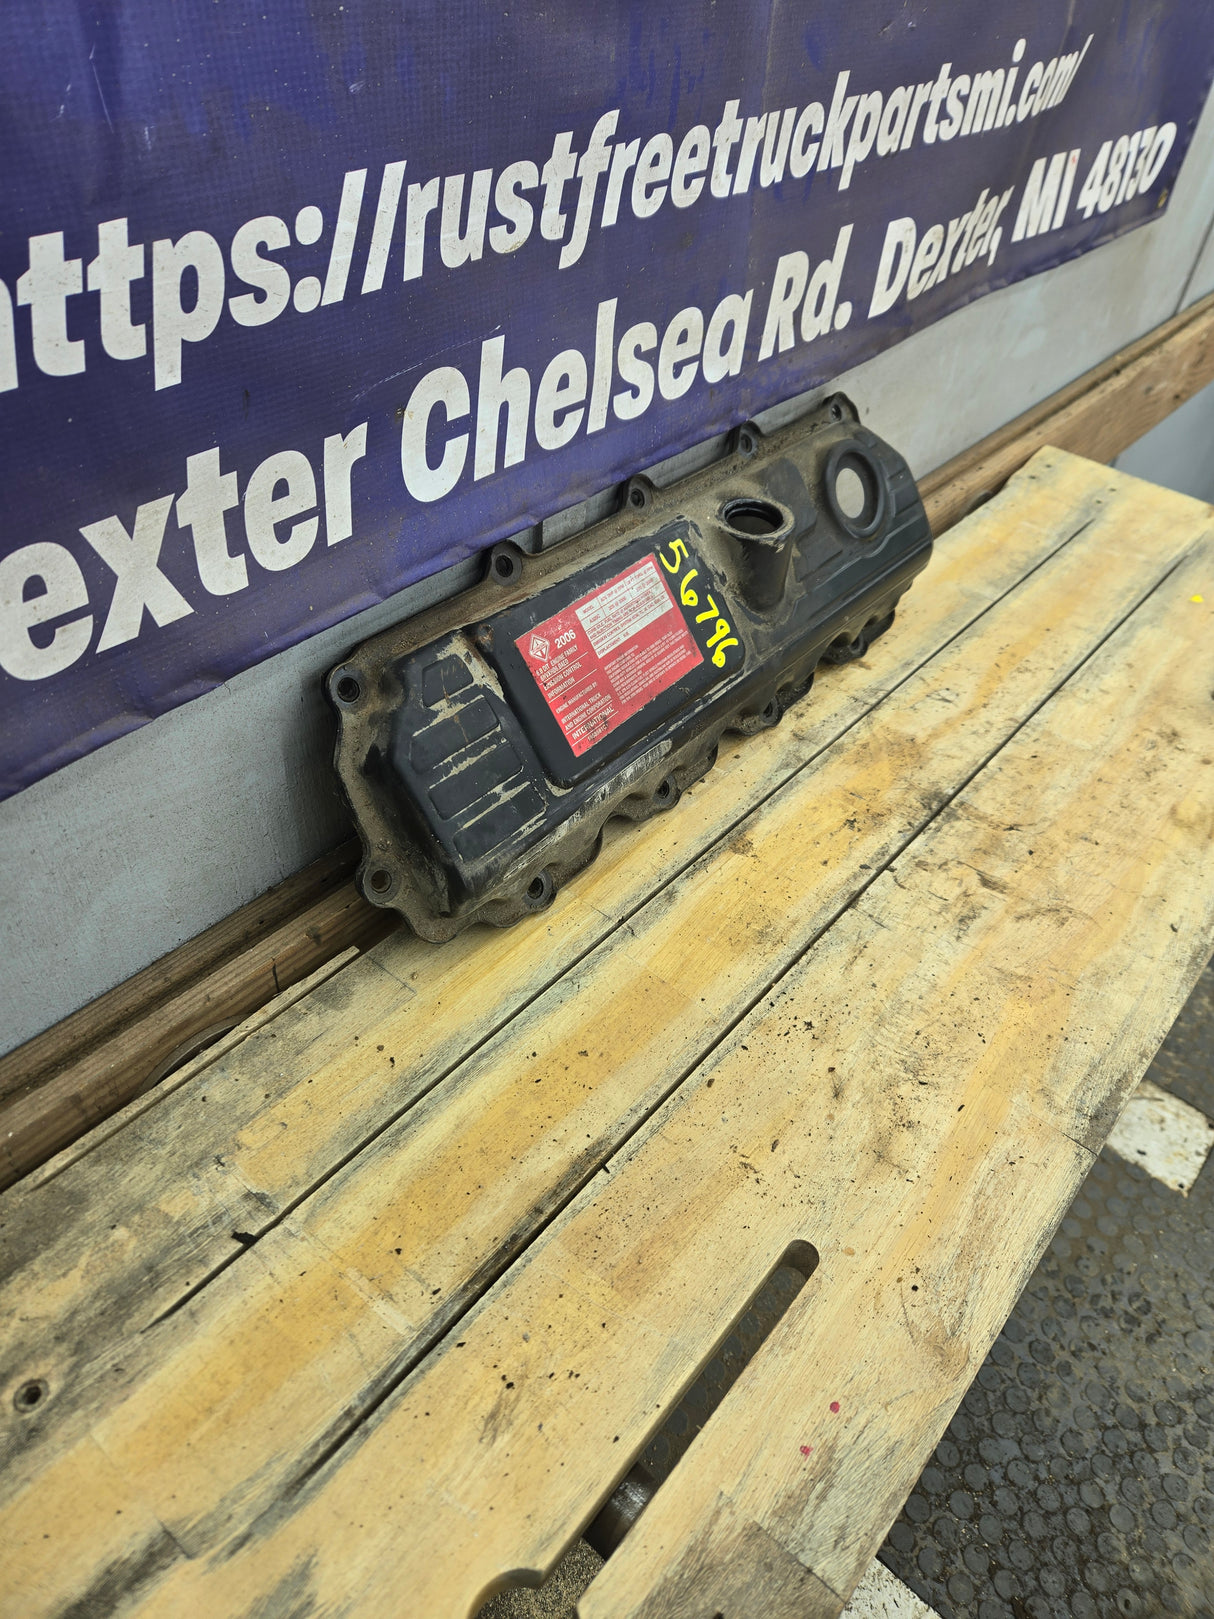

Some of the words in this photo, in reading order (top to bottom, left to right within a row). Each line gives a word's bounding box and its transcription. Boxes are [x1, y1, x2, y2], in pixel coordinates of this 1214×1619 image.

[401, 289, 754, 502] Chelsea
[758, 223, 853, 362] Rd.
[868, 185, 1015, 319] Dexter,
[1011, 148, 1081, 242] MI
[1076, 122, 1177, 219] 48130
[554, 628, 576, 648] 2006
[564, 644, 577, 656] FAMILY
[562, 661, 581, 676] CONTROL
[547, 676, 575, 698] INFORMATION
[561, 701, 589, 723] INTERNATIONAL
[588, 692, 601, 703] TRUCK
[573, 711, 586, 724] ENGINE
[586, 694, 611, 714] CORPORATION
[571, 705, 614, 739] INTERNATIONAL
